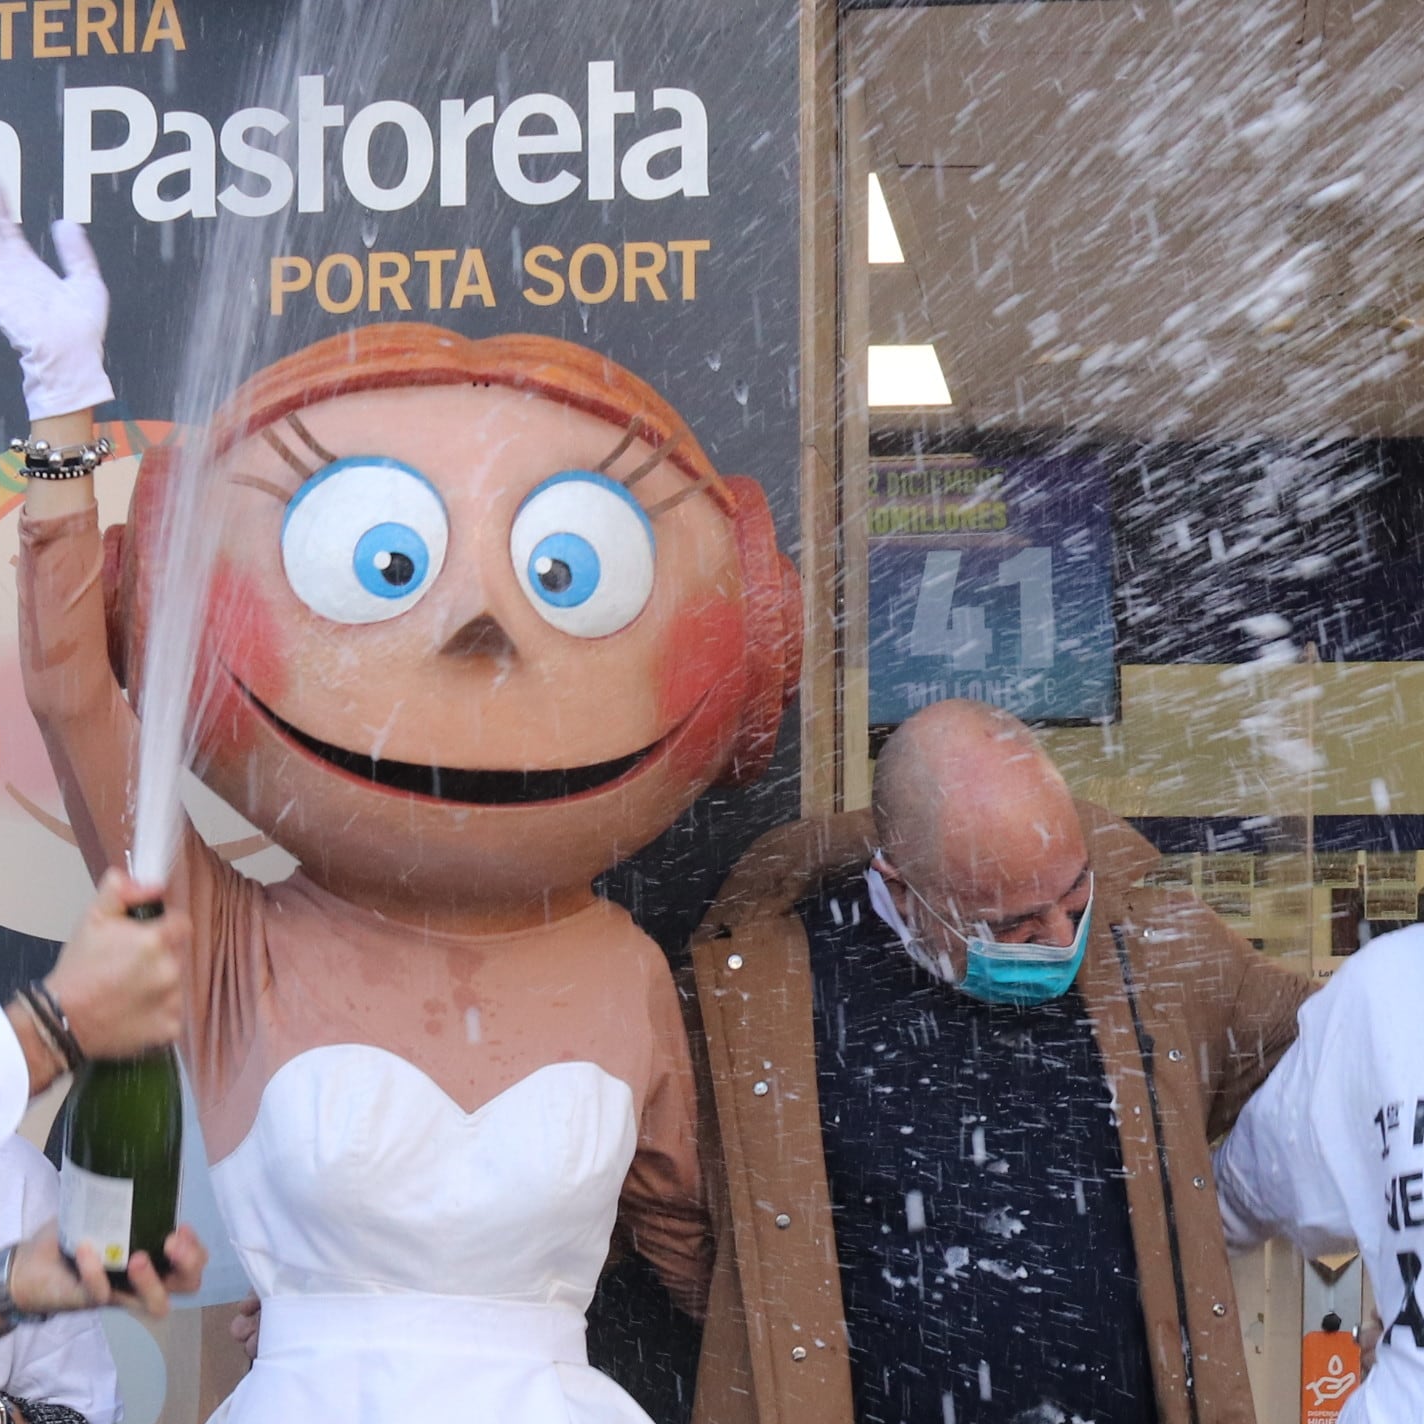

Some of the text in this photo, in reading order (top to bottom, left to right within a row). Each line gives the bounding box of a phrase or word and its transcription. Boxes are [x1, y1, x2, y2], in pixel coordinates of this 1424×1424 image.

[63, 60, 710, 224] Pastoreta
[270, 240, 710, 316] PORTA SORT
[887, 468, 1008, 497] DICIEMBRE
[910, 546, 1055, 670] 41
